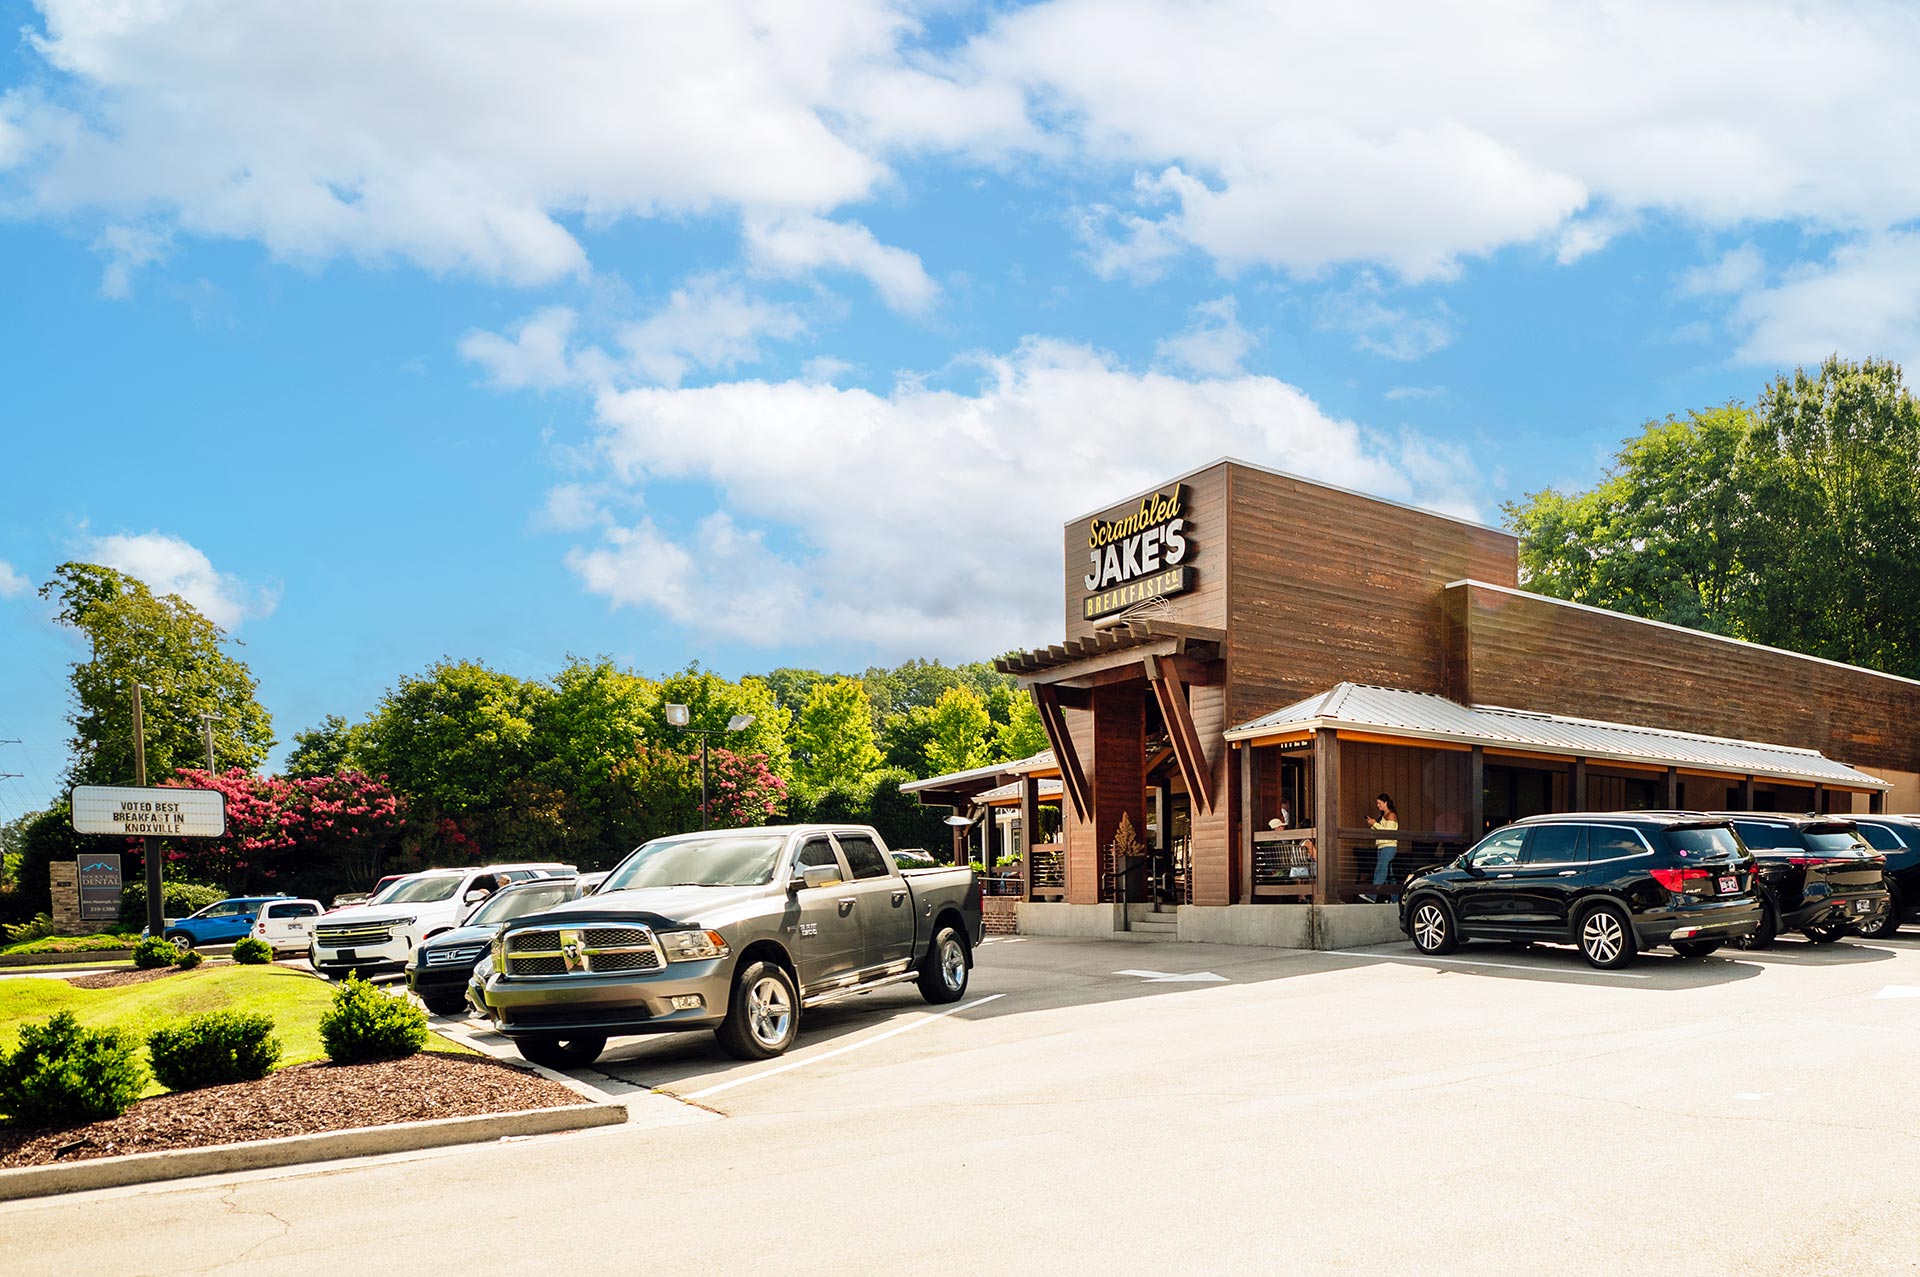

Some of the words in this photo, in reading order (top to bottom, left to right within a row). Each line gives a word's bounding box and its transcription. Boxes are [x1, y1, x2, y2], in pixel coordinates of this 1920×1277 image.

[1088, 483, 1181, 549] Scrambled
[1084, 518, 1186, 591] JAKE'S
[1087, 576, 1163, 617] BREAKFAST
[113, 812, 170, 823] BREAKFAST
[173, 813, 184, 823] IN
[121, 802, 152, 812] VOTED
[155, 803, 179, 812] BEST
[125, 823, 180, 833] KNOXVILLE
